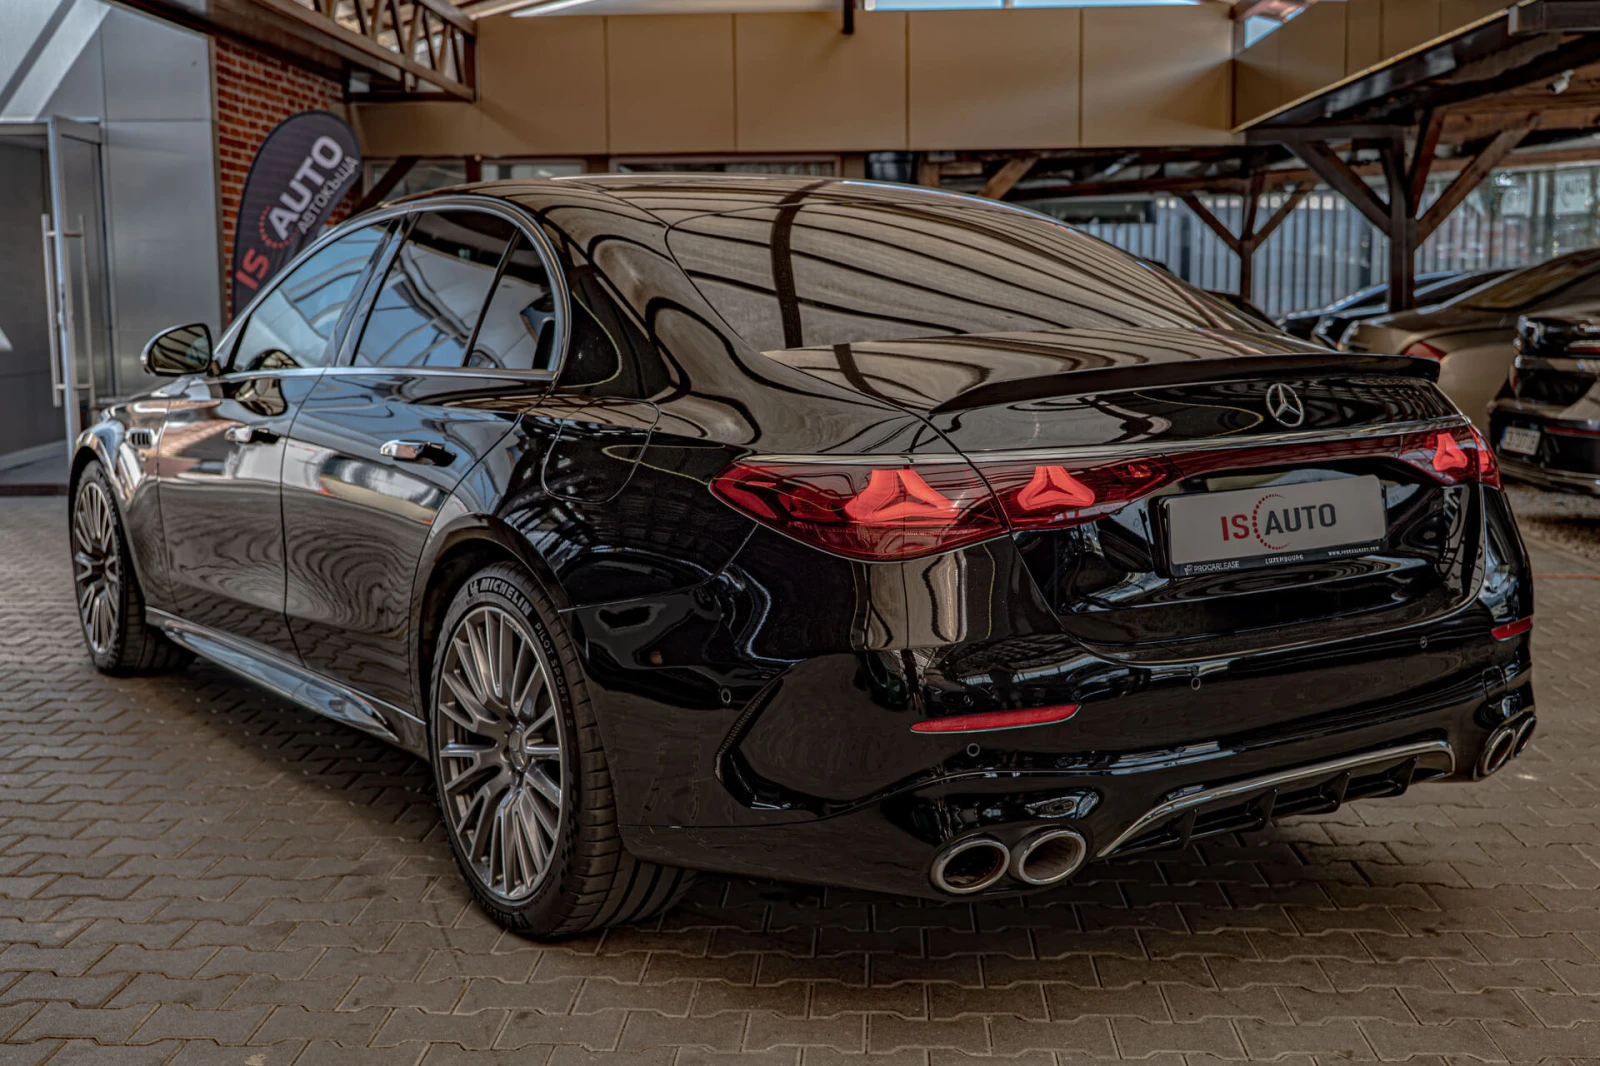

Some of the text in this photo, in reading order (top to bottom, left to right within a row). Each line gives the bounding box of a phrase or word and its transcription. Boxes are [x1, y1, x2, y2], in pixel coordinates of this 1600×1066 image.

[235, 136, 343, 290] IS AUTO
[1220, 503, 1337, 541] IS AUTO
[1194, 560, 1240, 573] PROCARLEASE
[479, 578, 533, 616] MICHELIN
[534, 622, 554, 655] PILOT
[551, 659, 569, 704] SPORT
